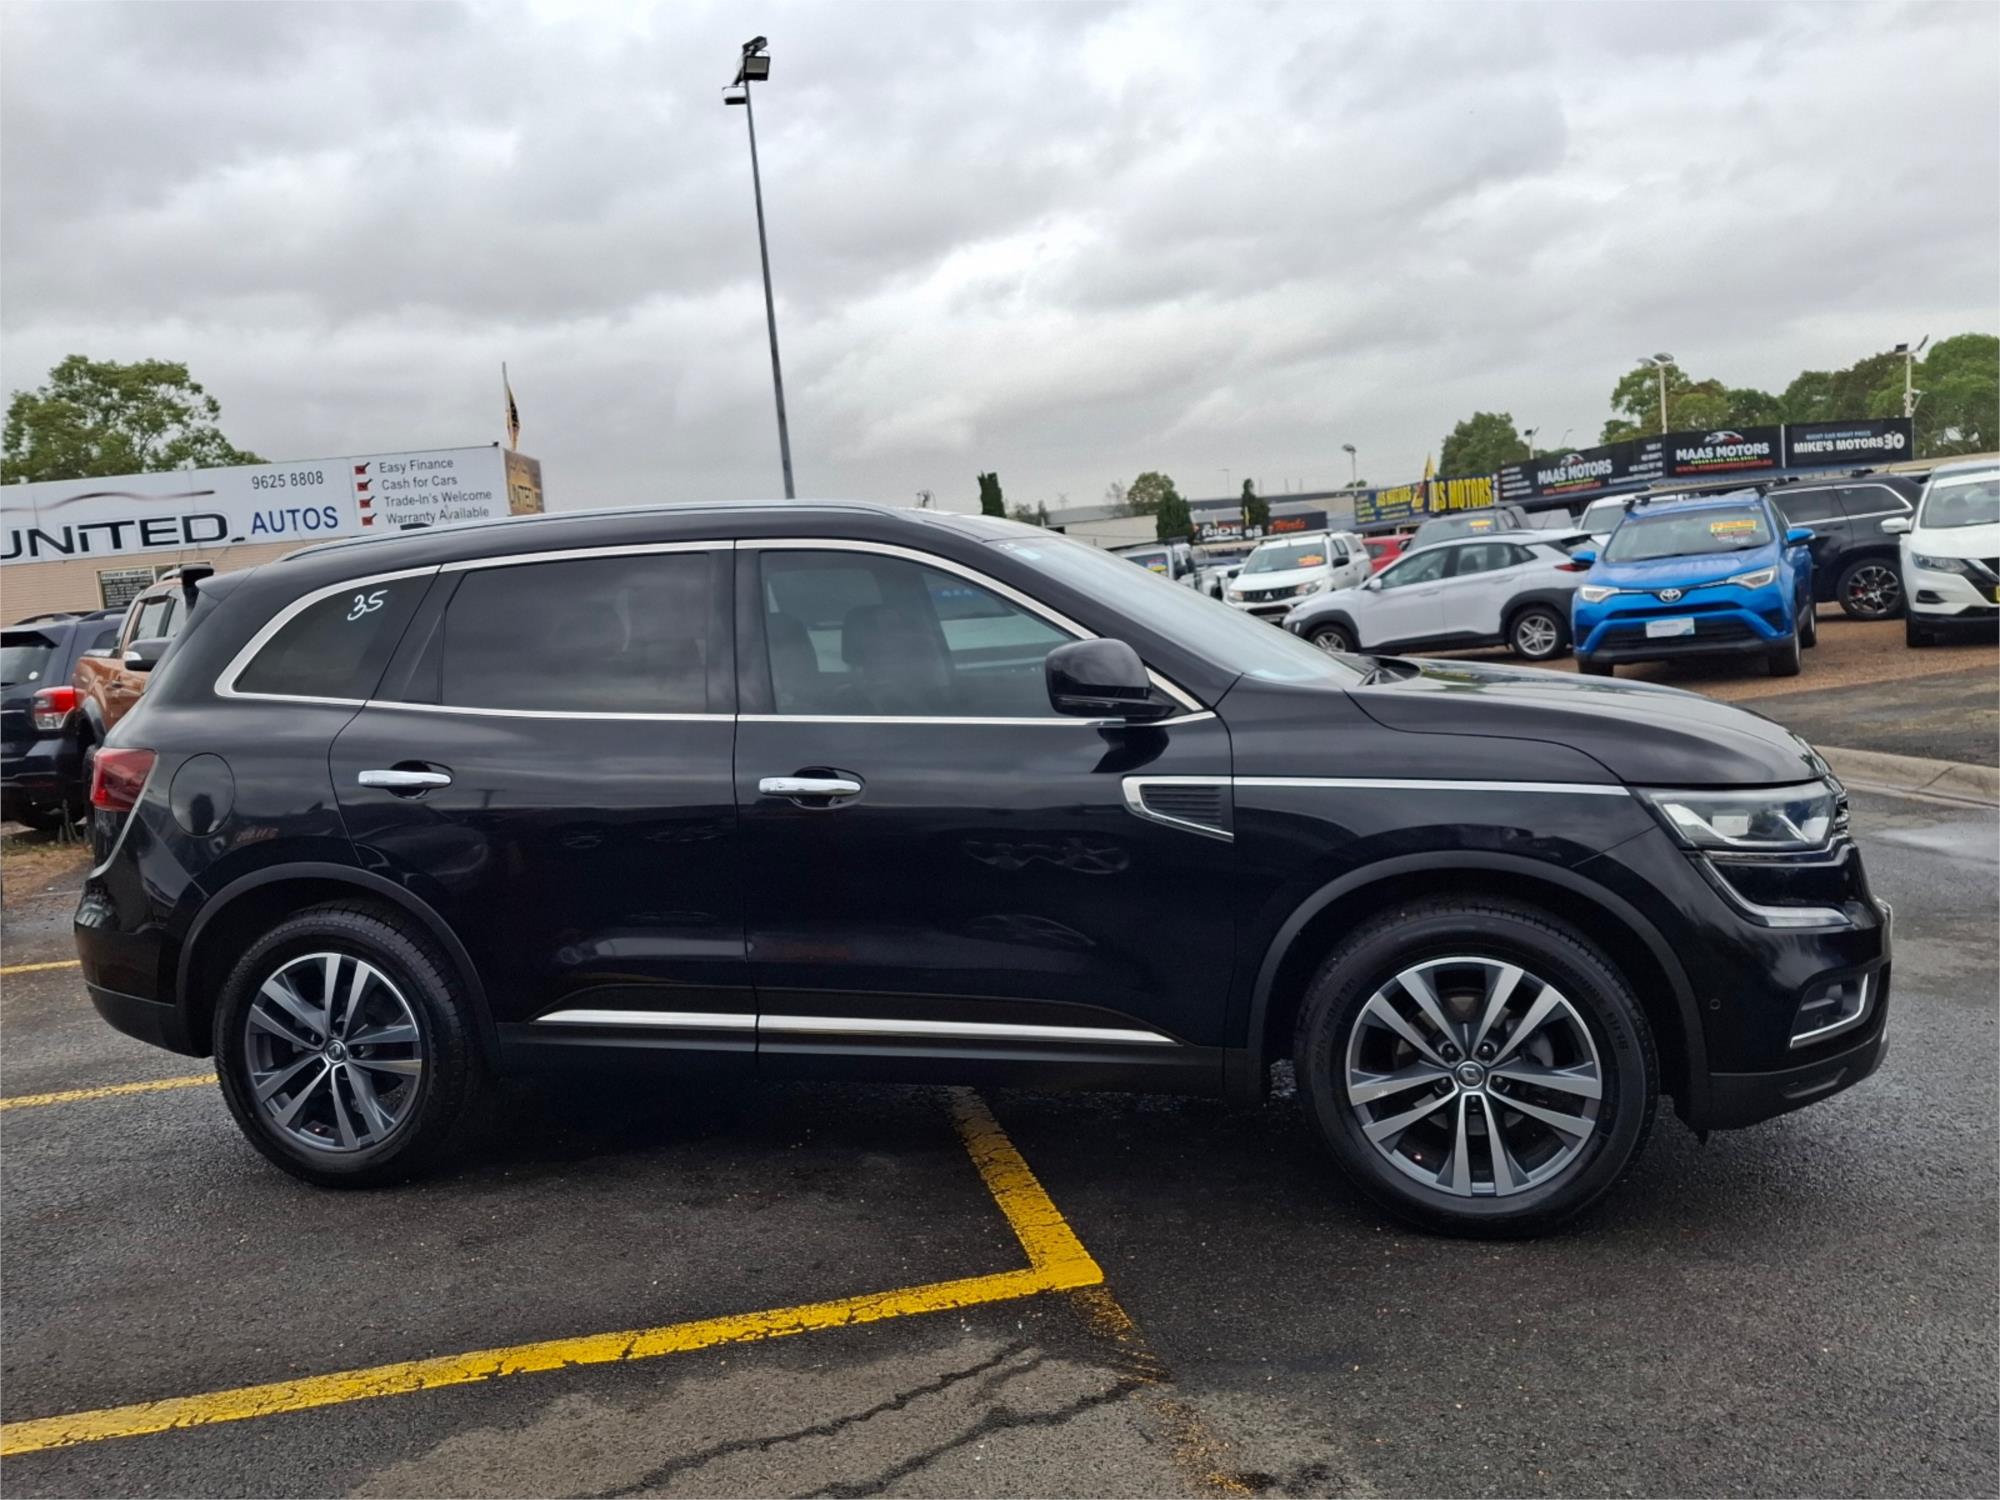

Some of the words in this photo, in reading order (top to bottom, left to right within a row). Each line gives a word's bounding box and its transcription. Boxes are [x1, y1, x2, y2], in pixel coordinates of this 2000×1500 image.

[1675, 446, 1714, 461] MAAS
[1716, 442, 1770, 457] MOTORS
[1793, 441, 1834, 454] MIKE'S
[1836, 436, 1884, 451] MOTORS
[379, 462, 406, 475] Easy
[410, 458, 454, 472] Finance
[1537, 466, 1566, 485] MAAS
[1568, 459, 1613, 480] MOTORS
[251, 473, 286, 490] 9625
[290, 470, 324, 487] 8808
[382, 478, 411, 491] Cash
[413, 476, 428, 488] for
[431, 475, 458, 487] Cars
[384, 493, 438, 508] Trade-In's
[441, 490, 493, 503] Welcome
[1448, 476, 1494, 509] MOTORS
[251, 506, 339, 535] AUTOS
[386, 510, 436, 525] Warranty
[439, 506, 490, 520] Available
[346, 589, 388, 621] 35
